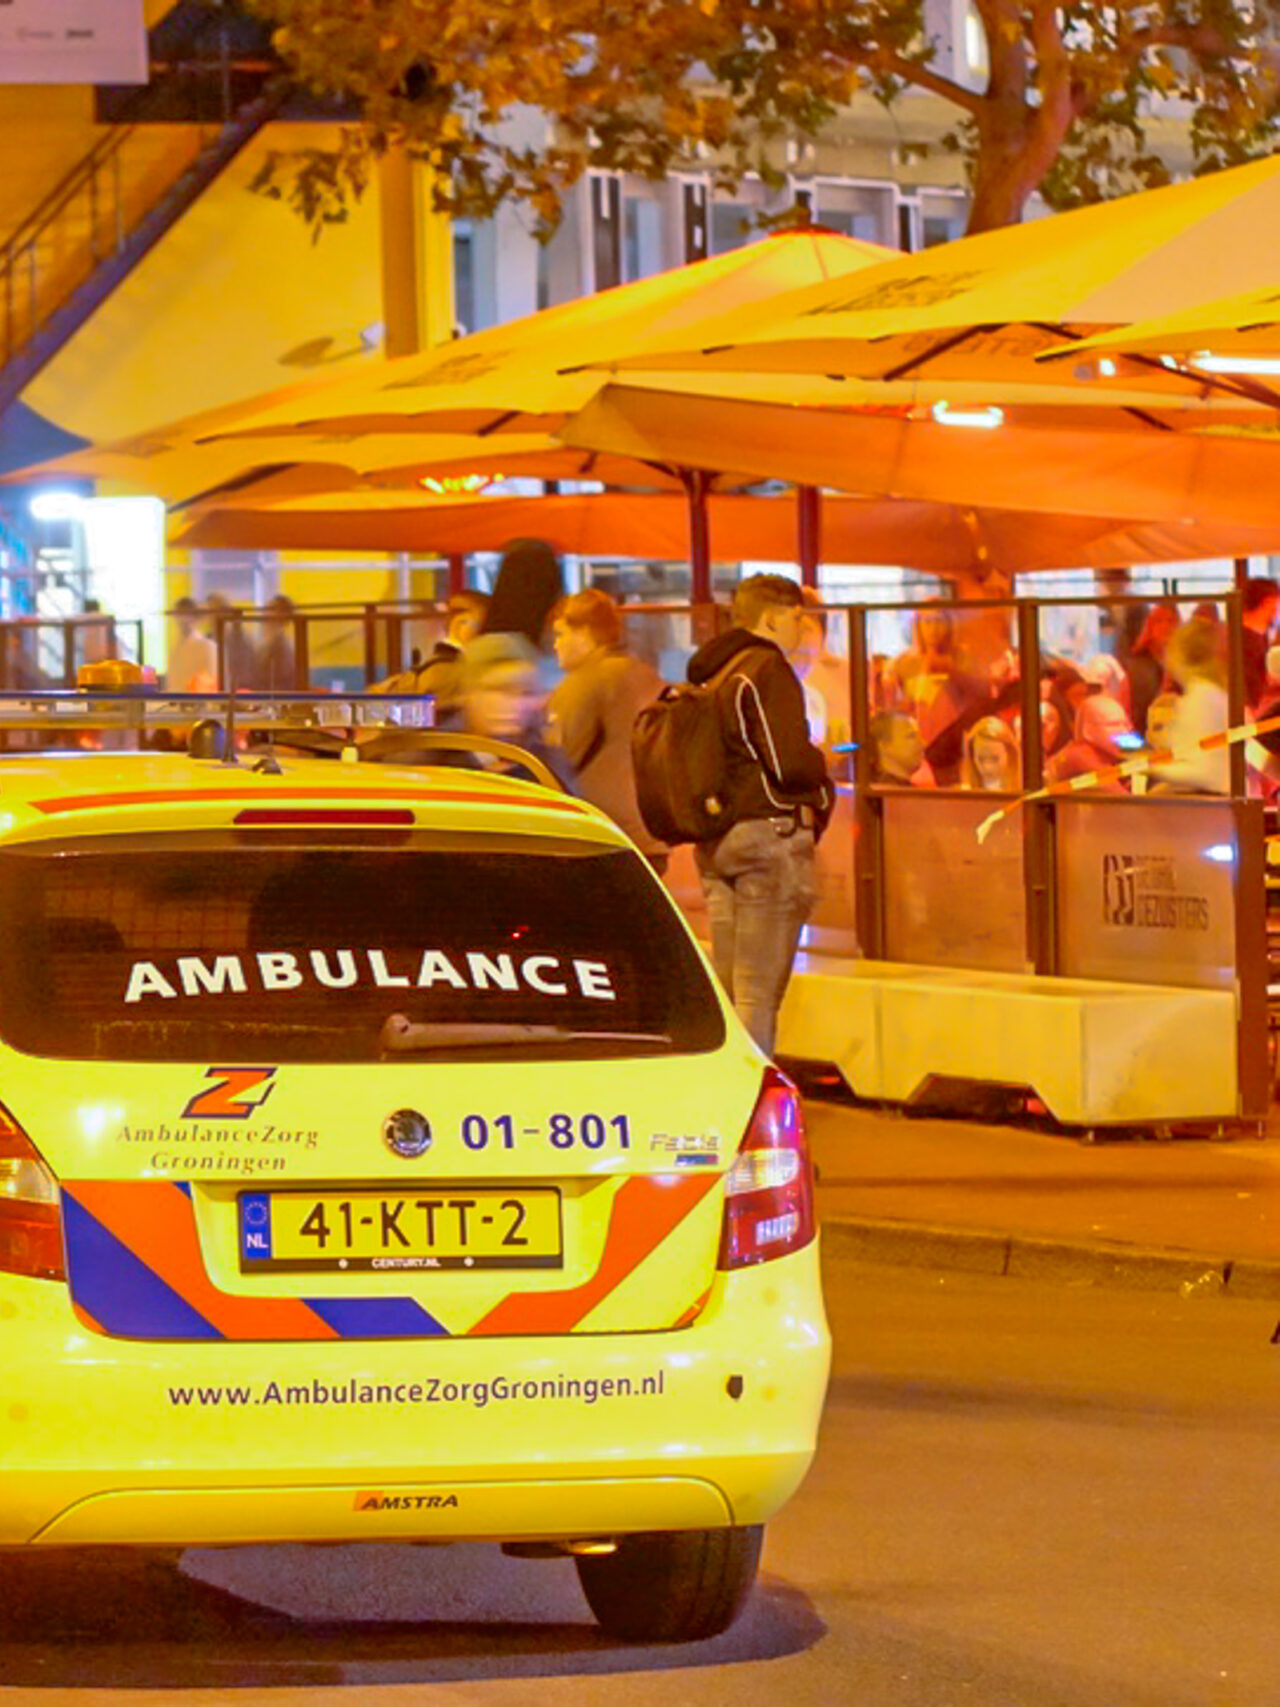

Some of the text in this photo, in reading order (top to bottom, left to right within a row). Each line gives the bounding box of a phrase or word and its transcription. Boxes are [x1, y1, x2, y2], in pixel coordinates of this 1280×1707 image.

[124, 949, 617, 1002] AMBULANCE
[117, 1124, 320, 1149] AmbulanceZorg
[462, 1113, 631, 1150] 01-801
[150, 1152, 287, 1175] Groningen
[299, 1199, 529, 1249] 41-KTT-2
[246, 1234, 269, 1249] NL
[169, 1371, 664, 1406] www.AmbulanceZorgGroningen.nl
[362, 1494, 459, 1511] AMSTRA
